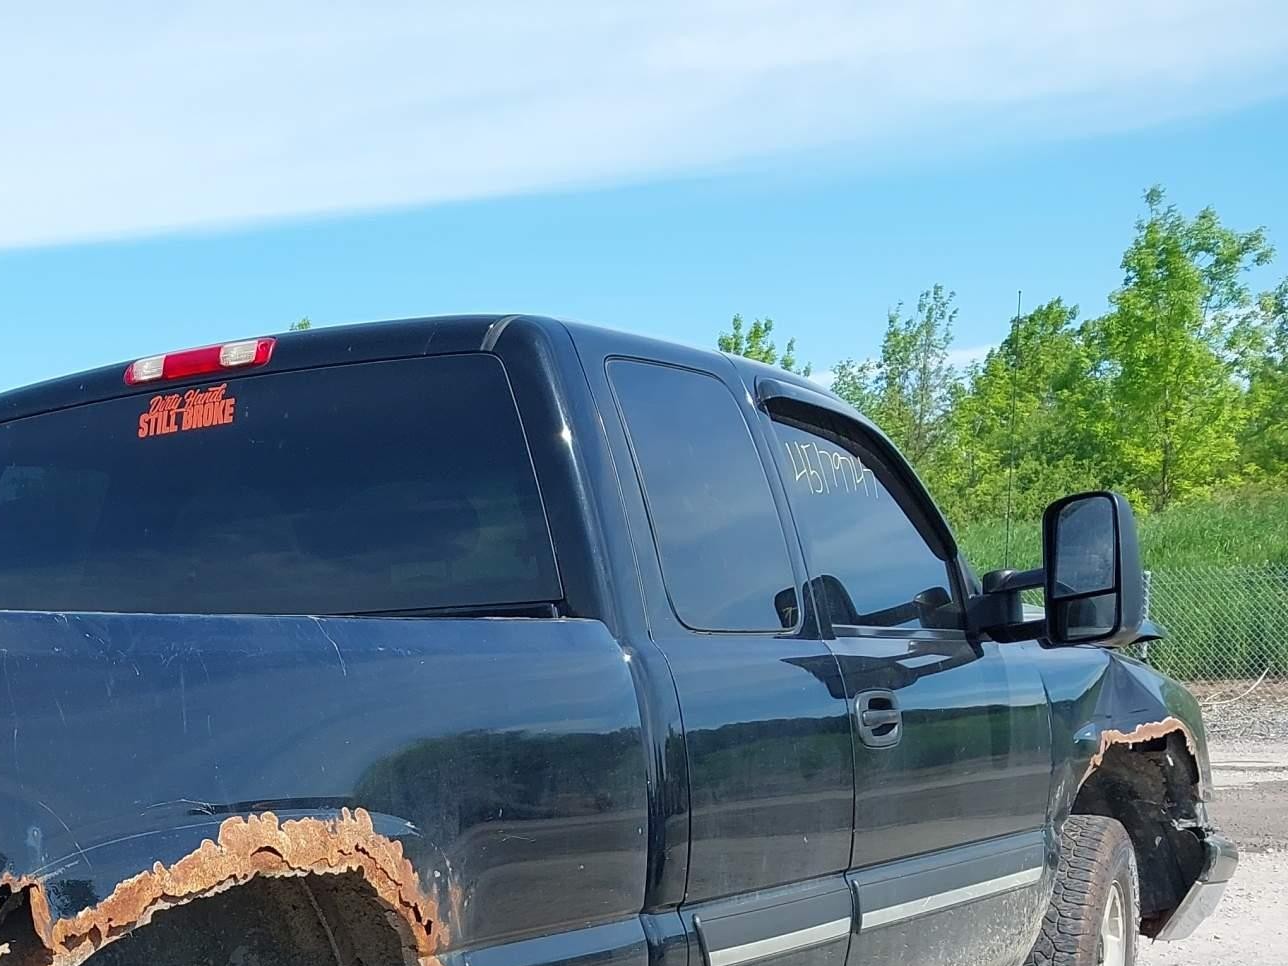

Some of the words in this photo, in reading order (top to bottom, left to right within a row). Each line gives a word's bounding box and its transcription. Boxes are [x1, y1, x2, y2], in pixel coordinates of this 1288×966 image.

[149, 393, 183, 416] Dirty
[184, 383, 227, 410] Hands
[138, 411, 178, 437] STILL
[182, 399, 235, 430] BROKE
